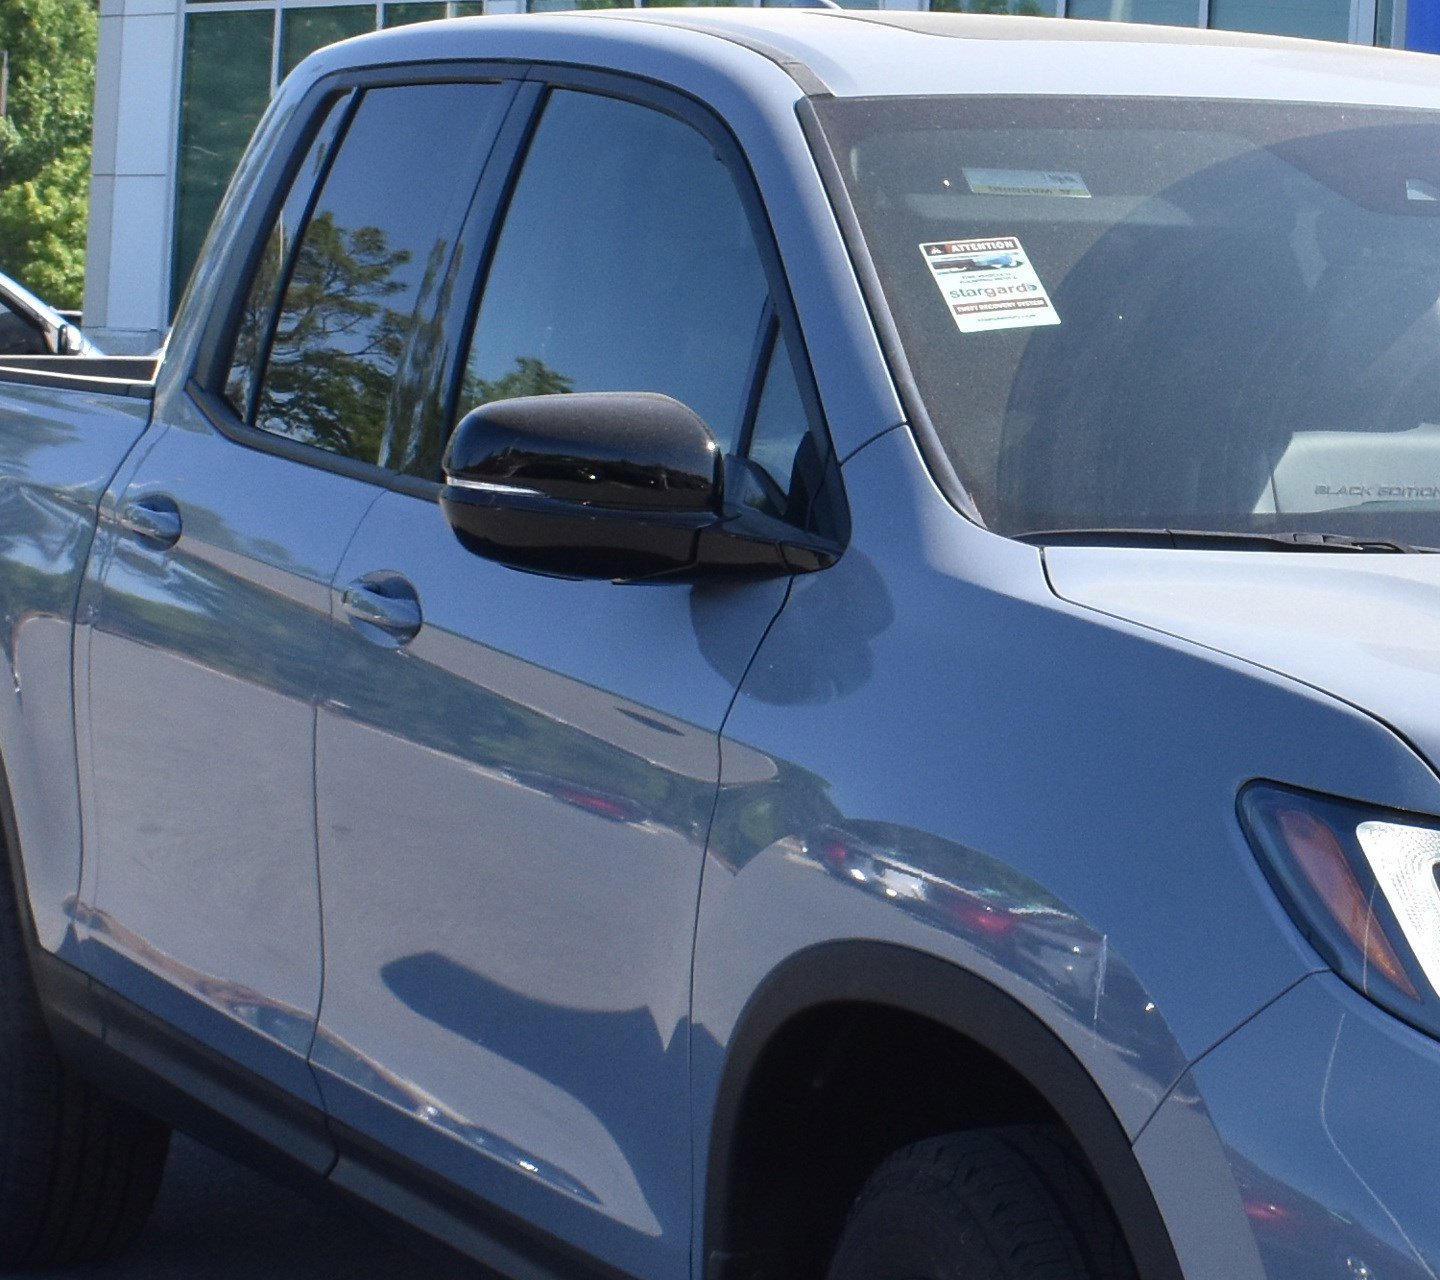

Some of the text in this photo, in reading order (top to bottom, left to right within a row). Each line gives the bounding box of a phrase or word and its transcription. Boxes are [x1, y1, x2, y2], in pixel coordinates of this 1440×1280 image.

[951, 240, 1015, 253] ATTENTION
[949, 283, 1028, 299] stargard
[1314, 485, 1372, 496] BLACK
